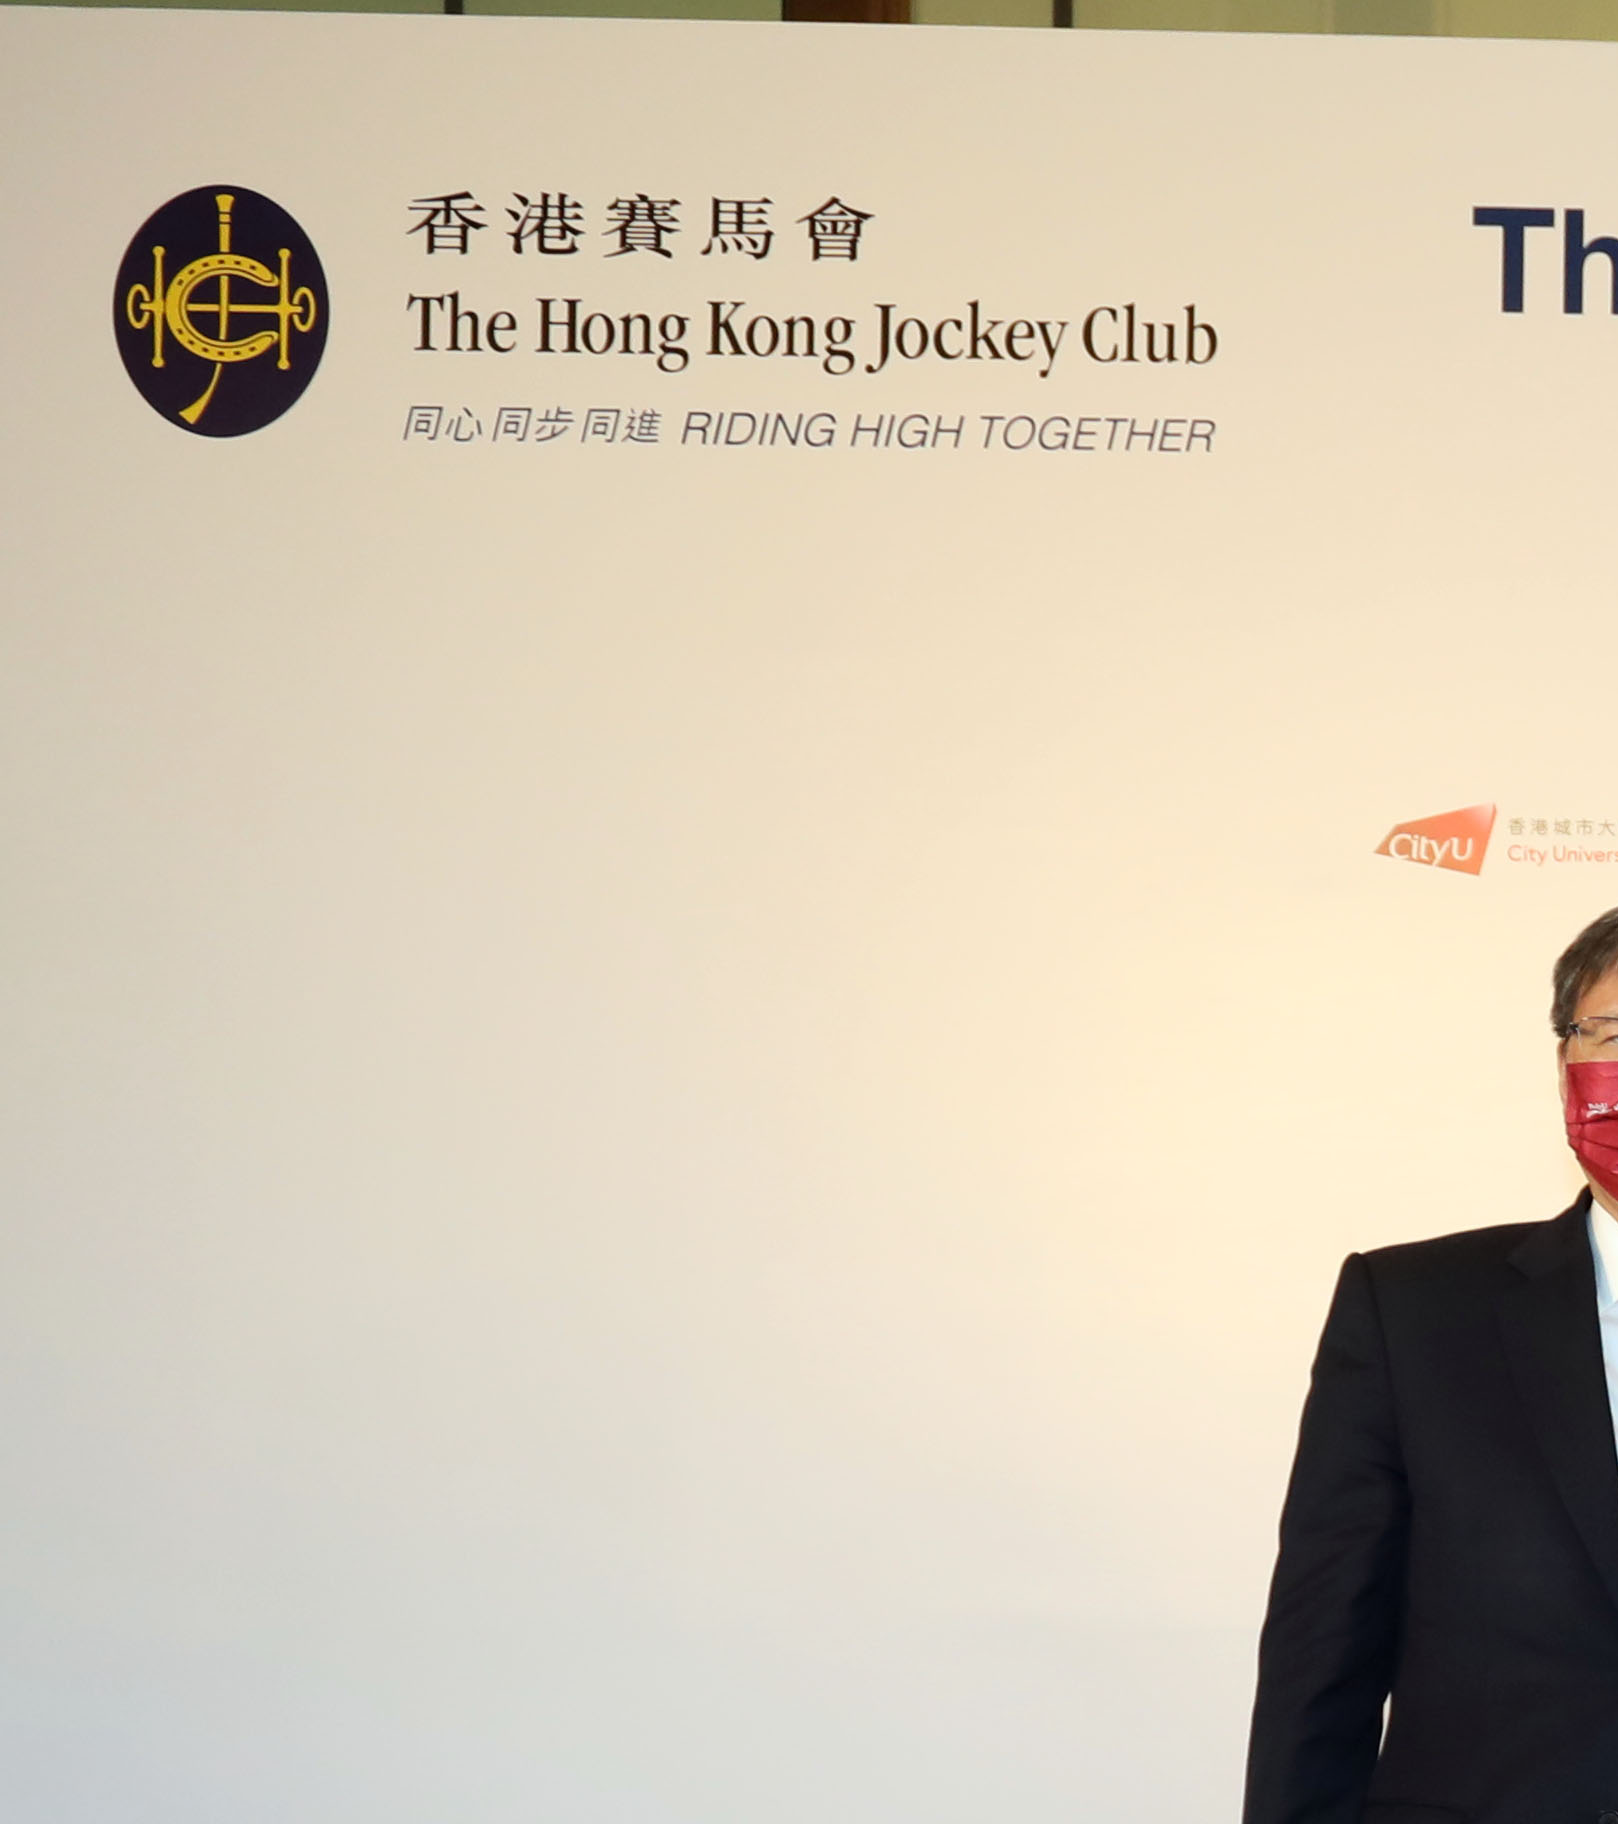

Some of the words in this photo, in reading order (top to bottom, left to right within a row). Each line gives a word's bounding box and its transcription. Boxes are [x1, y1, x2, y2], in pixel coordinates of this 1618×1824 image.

[406, 190, 875, 262] 香港賽馬會
[406, 290, 517, 353] The
[535, 298, 690, 373] Hong
[706, 300, 856, 376] Kong
[864, 299, 1069, 379] Jockey
[1082, 302, 1218, 365] Club
[680, 411, 837, 448] RIDING
[849, 413, 965, 449] HIGH
[979, 415, 1217, 453] TOGETHER
[1388, 832, 1472, 867] CityU
[1506, 843, 1548, 867] City
